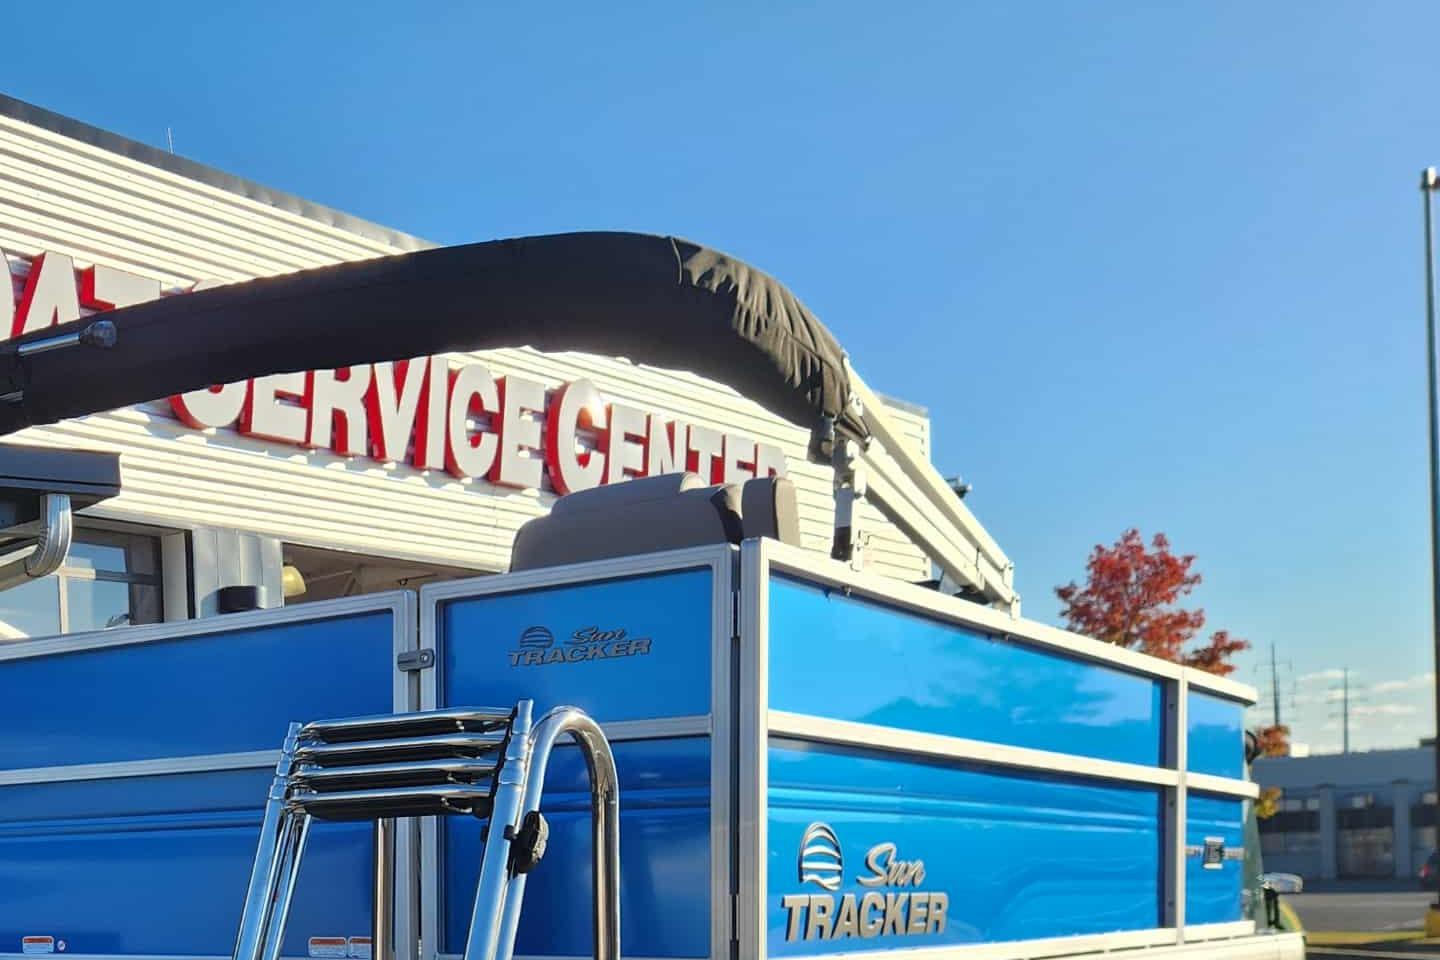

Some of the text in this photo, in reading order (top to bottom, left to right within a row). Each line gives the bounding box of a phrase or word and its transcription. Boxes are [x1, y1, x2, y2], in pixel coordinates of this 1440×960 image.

[509, 639, 652, 667] TRACKER
[571, 626, 627, 644] Sun
[856, 842, 926, 887] Sun
[782, 892, 948, 943] TRACKER
